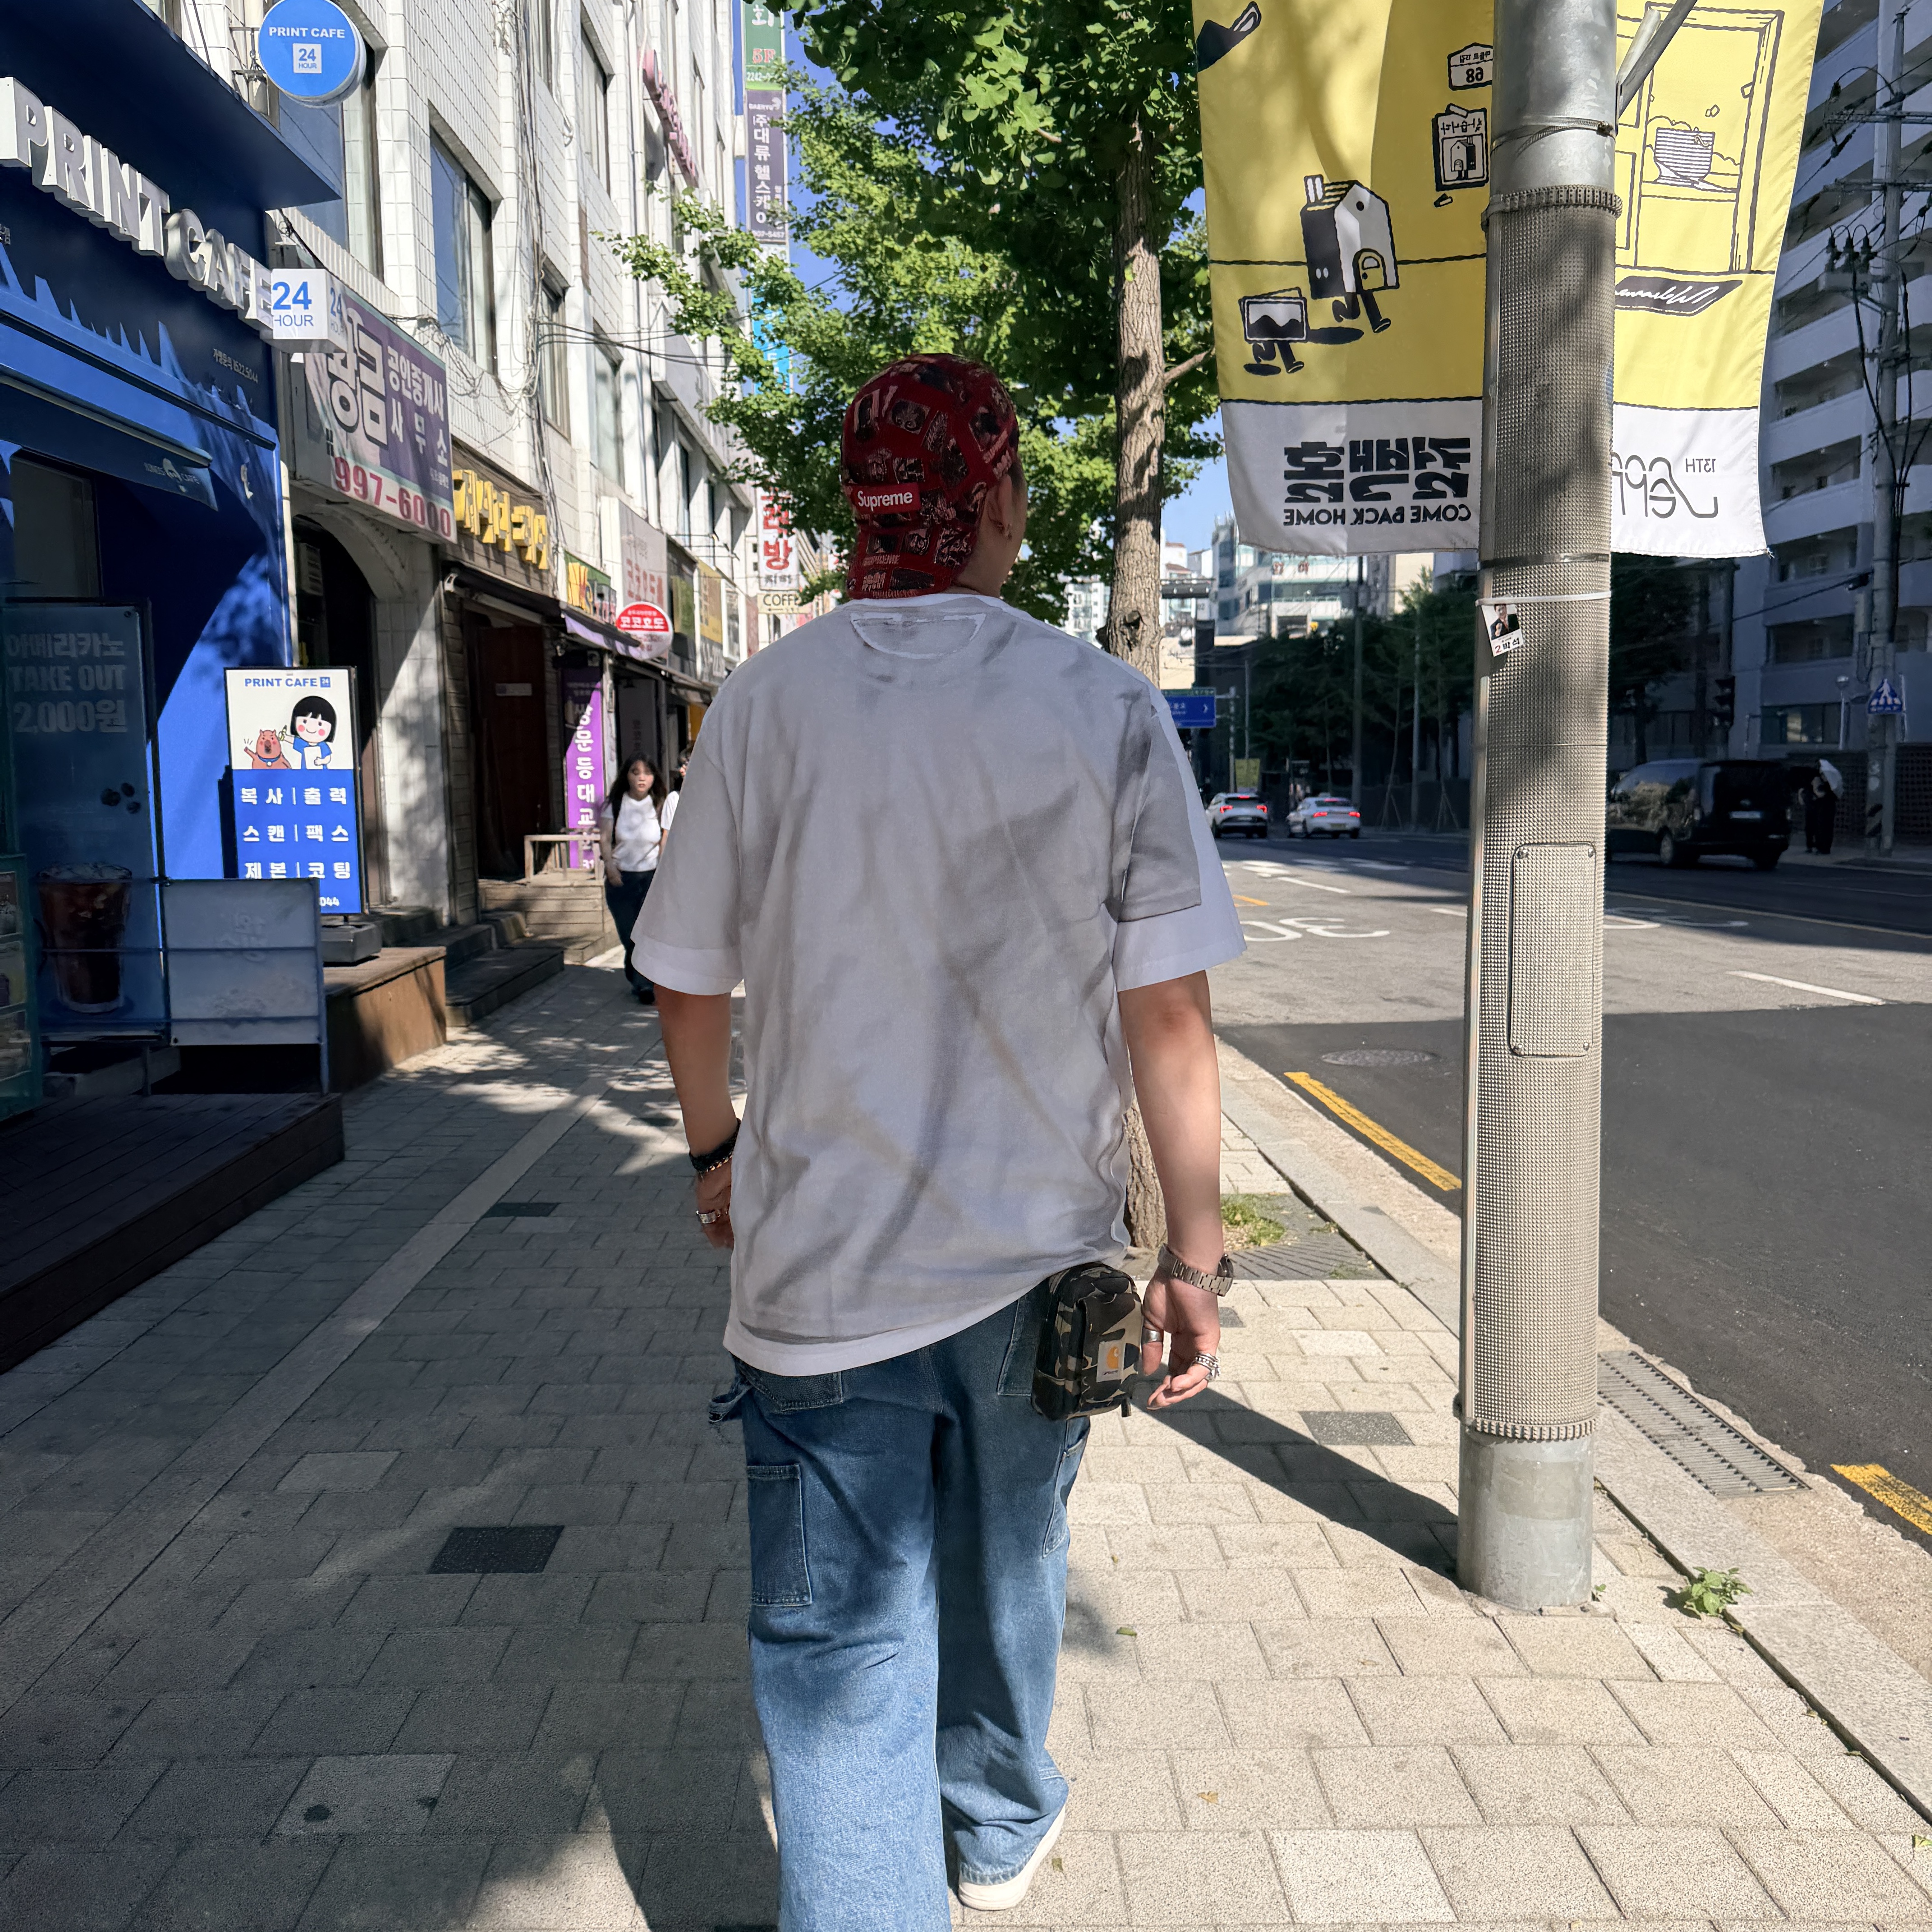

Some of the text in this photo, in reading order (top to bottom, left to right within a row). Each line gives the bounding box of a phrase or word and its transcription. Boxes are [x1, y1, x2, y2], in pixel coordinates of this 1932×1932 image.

[269, 27, 345, 38] PRINT CAFE
[299, 48, 316, 61] 24
[752, 48, 776, 64] 5F
[0, 77, 274, 334] PRINT CAFE
[272, 281, 312, 310] 24
[273, 314, 314, 327] HOUR
[387, 345, 444, 422] 공인중개사
[334, 455, 451, 537] 997-6000
[857, 490, 913, 511] Supreme
[8, 664, 127, 692] TAKE OUT
[244, 678, 282, 687] PRINT
[285, 678, 318, 687] CAFE
[15, 699, 129, 734] 2,000원
